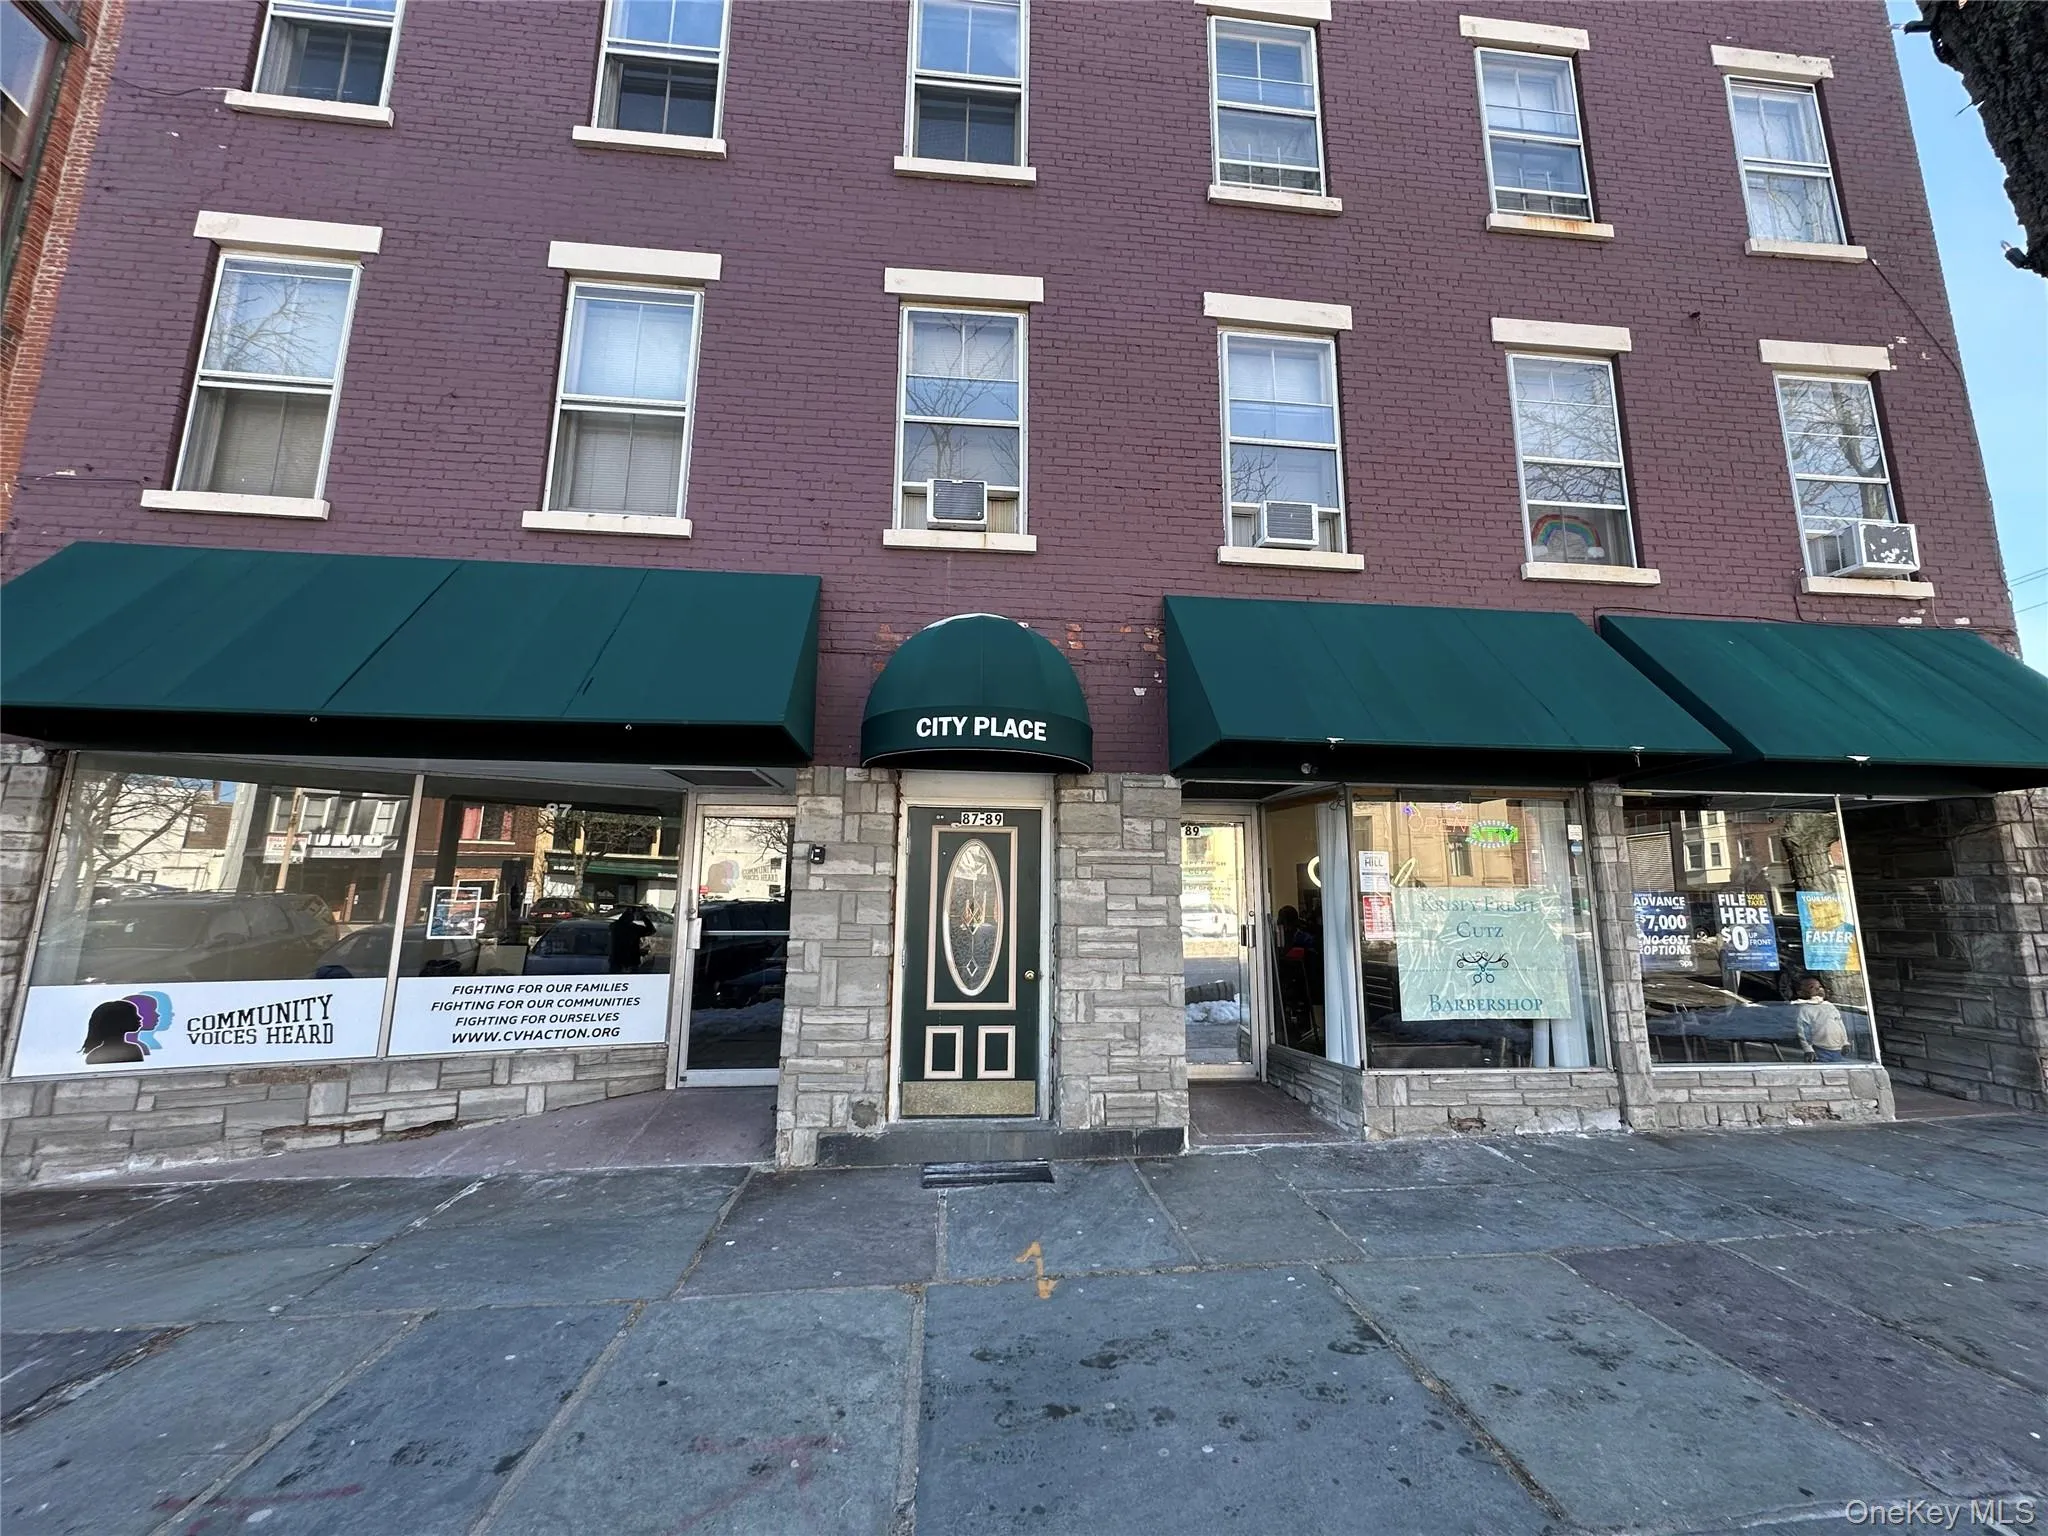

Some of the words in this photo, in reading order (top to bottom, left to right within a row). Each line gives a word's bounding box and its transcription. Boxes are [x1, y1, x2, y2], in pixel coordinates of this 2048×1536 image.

[915, 717, 968, 738] CITY
[974, 716, 1048, 742] PLACE
[546, 803, 572, 817] 87
[961, 813, 1003, 826] 87-89
[1184, 826, 1200, 836] 89
[1421, 896, 1479, 912] KRISPY
[1483, 895, 1535, 912] FRESH
[1633, 896, 1686, 907] ADVANCE
[1718, 893, 1746, 906] FILE
[1640, 914, 1687, 931] $7,000
[1719, 907, 1770, 924] HERE
[1456, 921, 1504, 938] CUTZ
[1643, 935, 1660, 945] NO
[1661, 935, 1690, 945] COST
[1721, 925, 1749, 952] $0
[1749, 938, 1772, 946] FRONT
[1805, 931, 1854, 944] FASTER
[1643, 945, 1692, 956] OPTIONS
[452, 985, 514, 995] FIGHTING
[517, 984, 543, 994] FOR
[545, 984, 572, 993] OUR
[574, 982, 630, 993] FAMILIES
[431, 1001, 495, 1011] FIGHTING
[497, 1000, 524, 1010] FOR
[526, 999, 554, 1009] OUR
[556, 997, 641, 1008] COMMUNITIES
[1428, 994, 1543, 1013] BARBERSHOP
[187, 993, 333, 1032] COMMUNITY
[455, 1015, 517, 1026] FIGHTING
[520, 1015, 546, 1025] FOR
[549, 1012, 620, 1023] OURSELVES
[187, 1028, 257, 1045] VOICES
[266, 1022, 334, 1045] HEARD
[451, 1027, 621, 1044] WWW.CVHACTION.ORG
